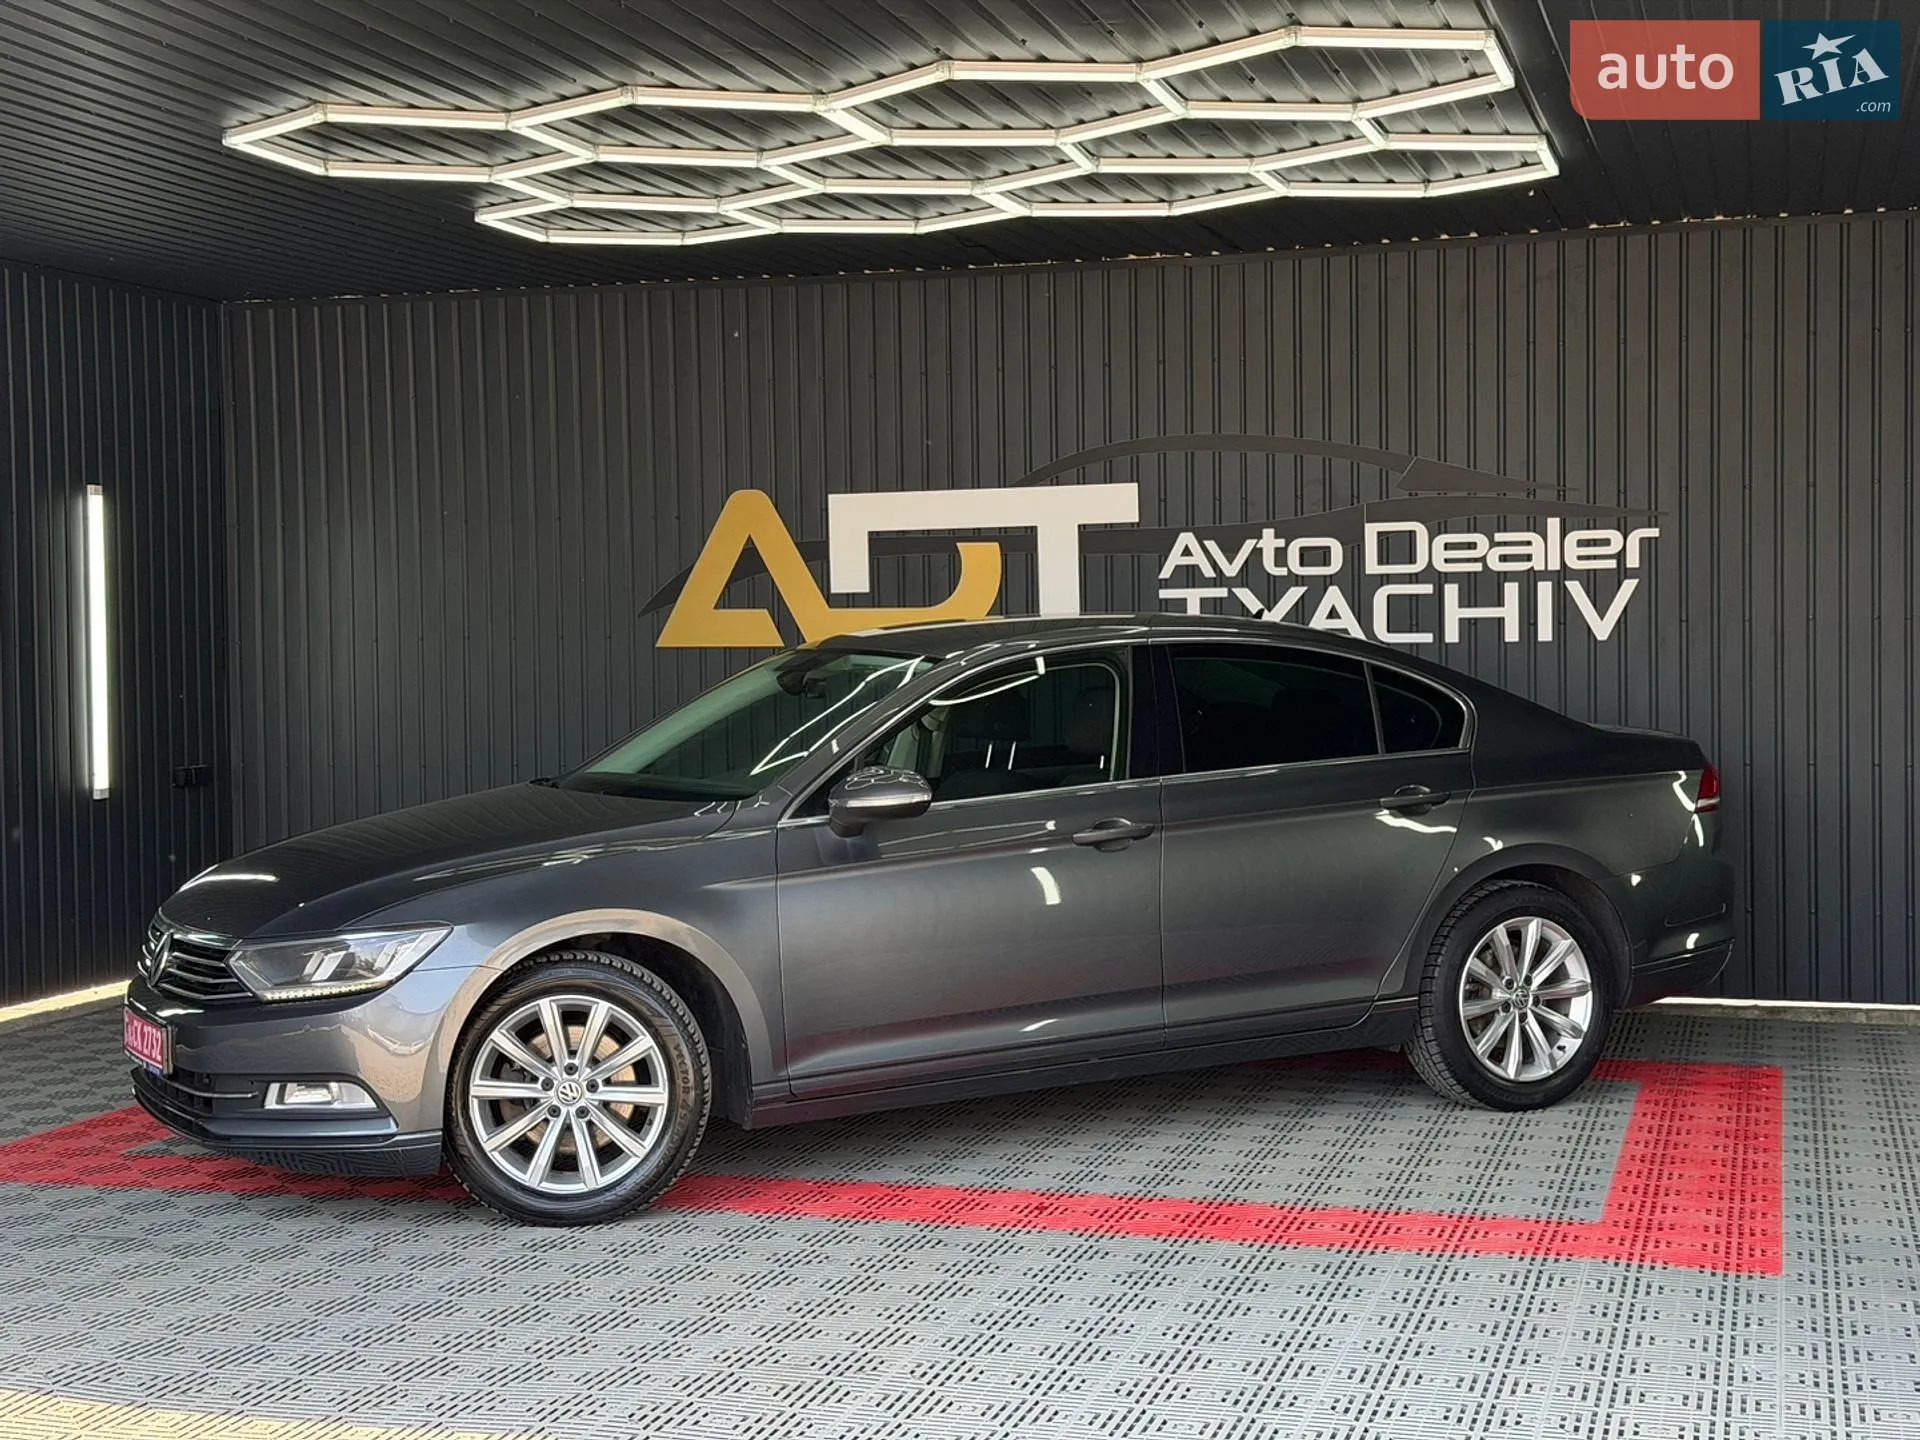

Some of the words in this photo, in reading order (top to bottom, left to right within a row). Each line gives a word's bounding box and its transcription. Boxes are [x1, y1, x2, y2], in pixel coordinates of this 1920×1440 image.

[1158, 528, 1344, 580] Avto
[1365, 517, 1660, 576] Dealer
[1158, 579, 1640, 644] TYACHIV
